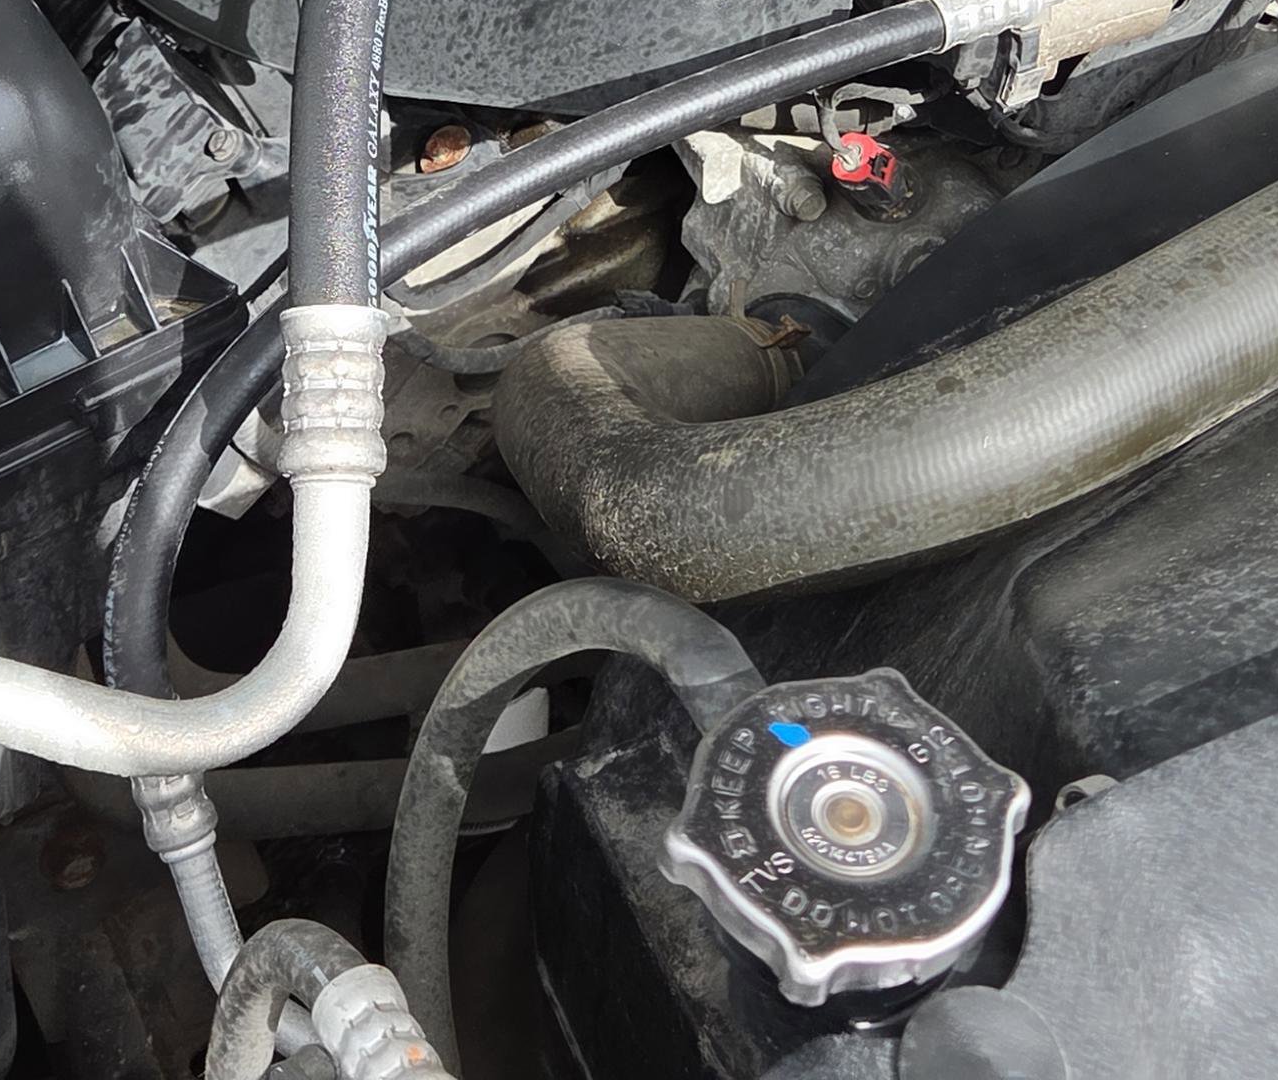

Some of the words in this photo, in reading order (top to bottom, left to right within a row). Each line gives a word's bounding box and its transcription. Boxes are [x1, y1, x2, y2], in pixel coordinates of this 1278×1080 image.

[371, 38, 383, 71] 4880
[367, 70, 380, 159] GALAXY
[907, 725, 956, 764] G12
[711, 728, 756, 819] KEEP
[739, 851, 795, 894] TVS
[781, 887, 834, 928] DO
